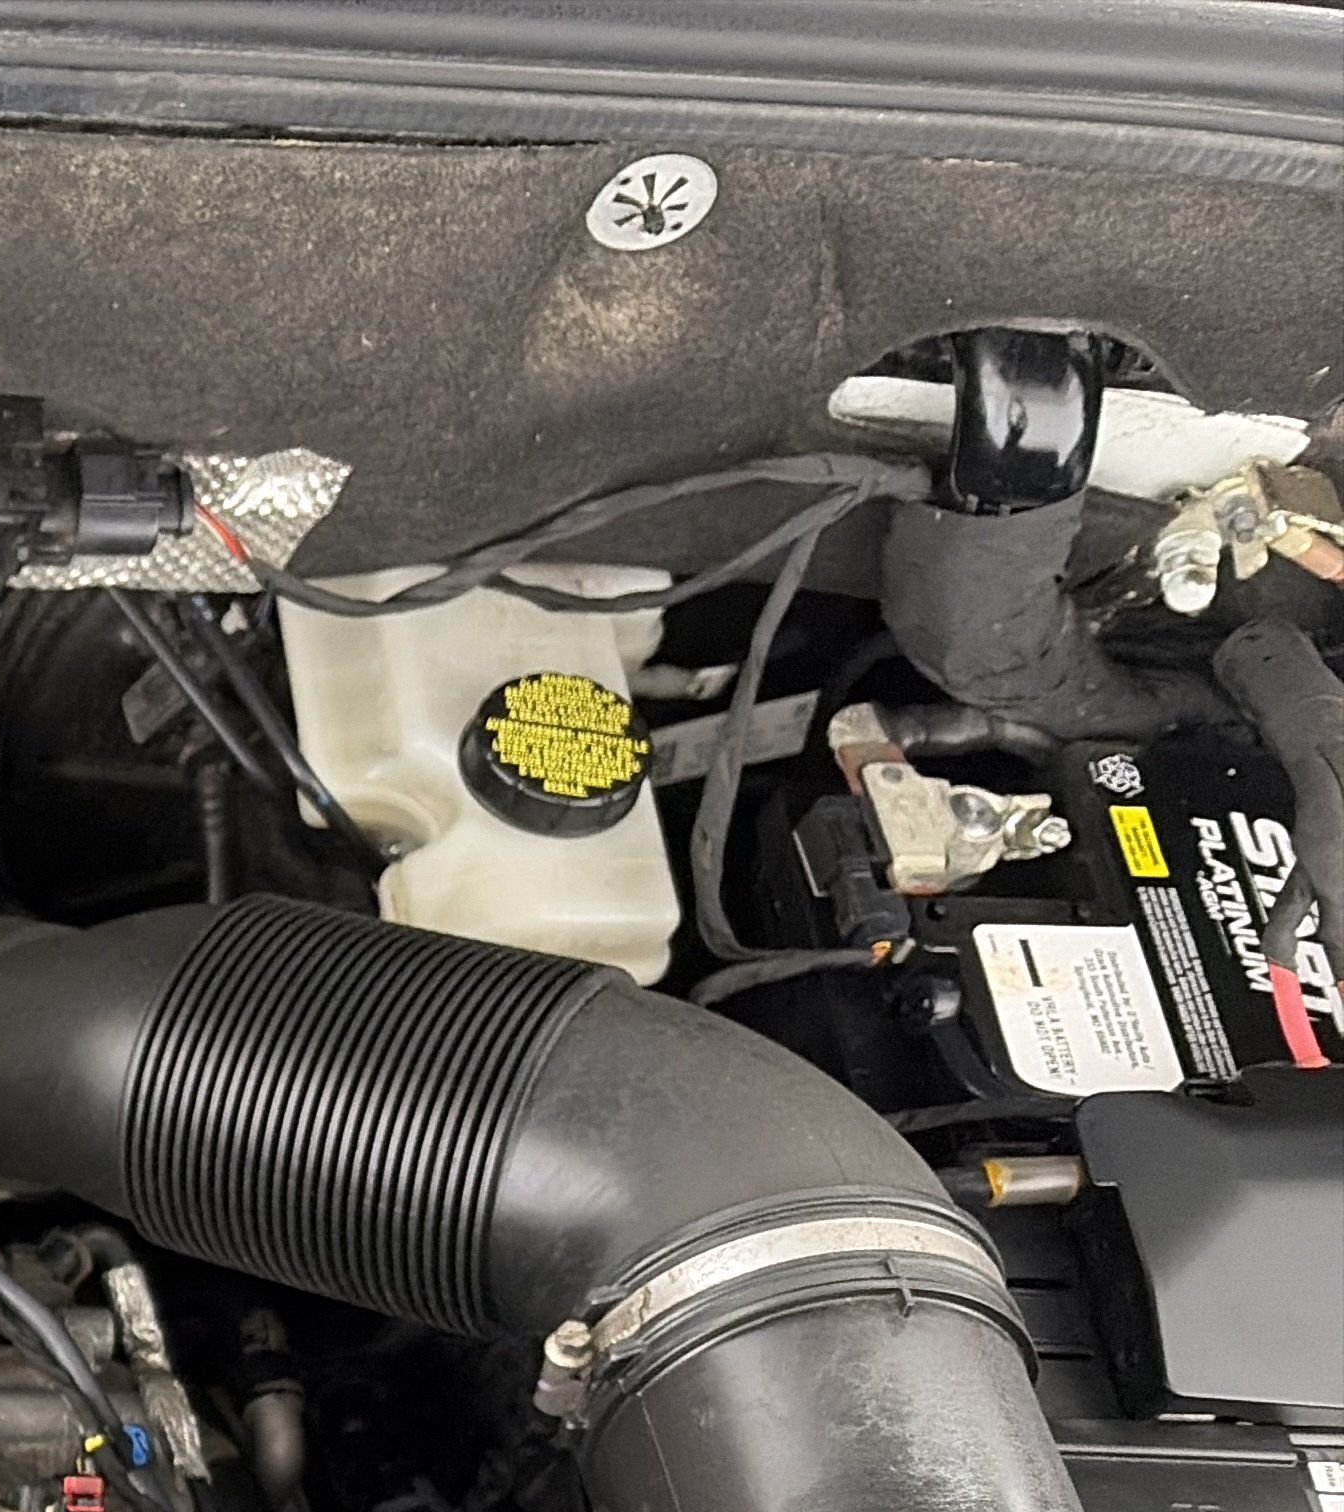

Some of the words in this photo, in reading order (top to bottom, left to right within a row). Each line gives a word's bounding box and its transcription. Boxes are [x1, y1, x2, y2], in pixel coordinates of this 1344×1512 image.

[1190, 816, 1273, 993] PLATINUM
[1033, 1019, 1052, 1042] NOT
[1041, 995, 1061, 1024] VRLA
[1051, 1026, 1079, 1077] BATTERY
